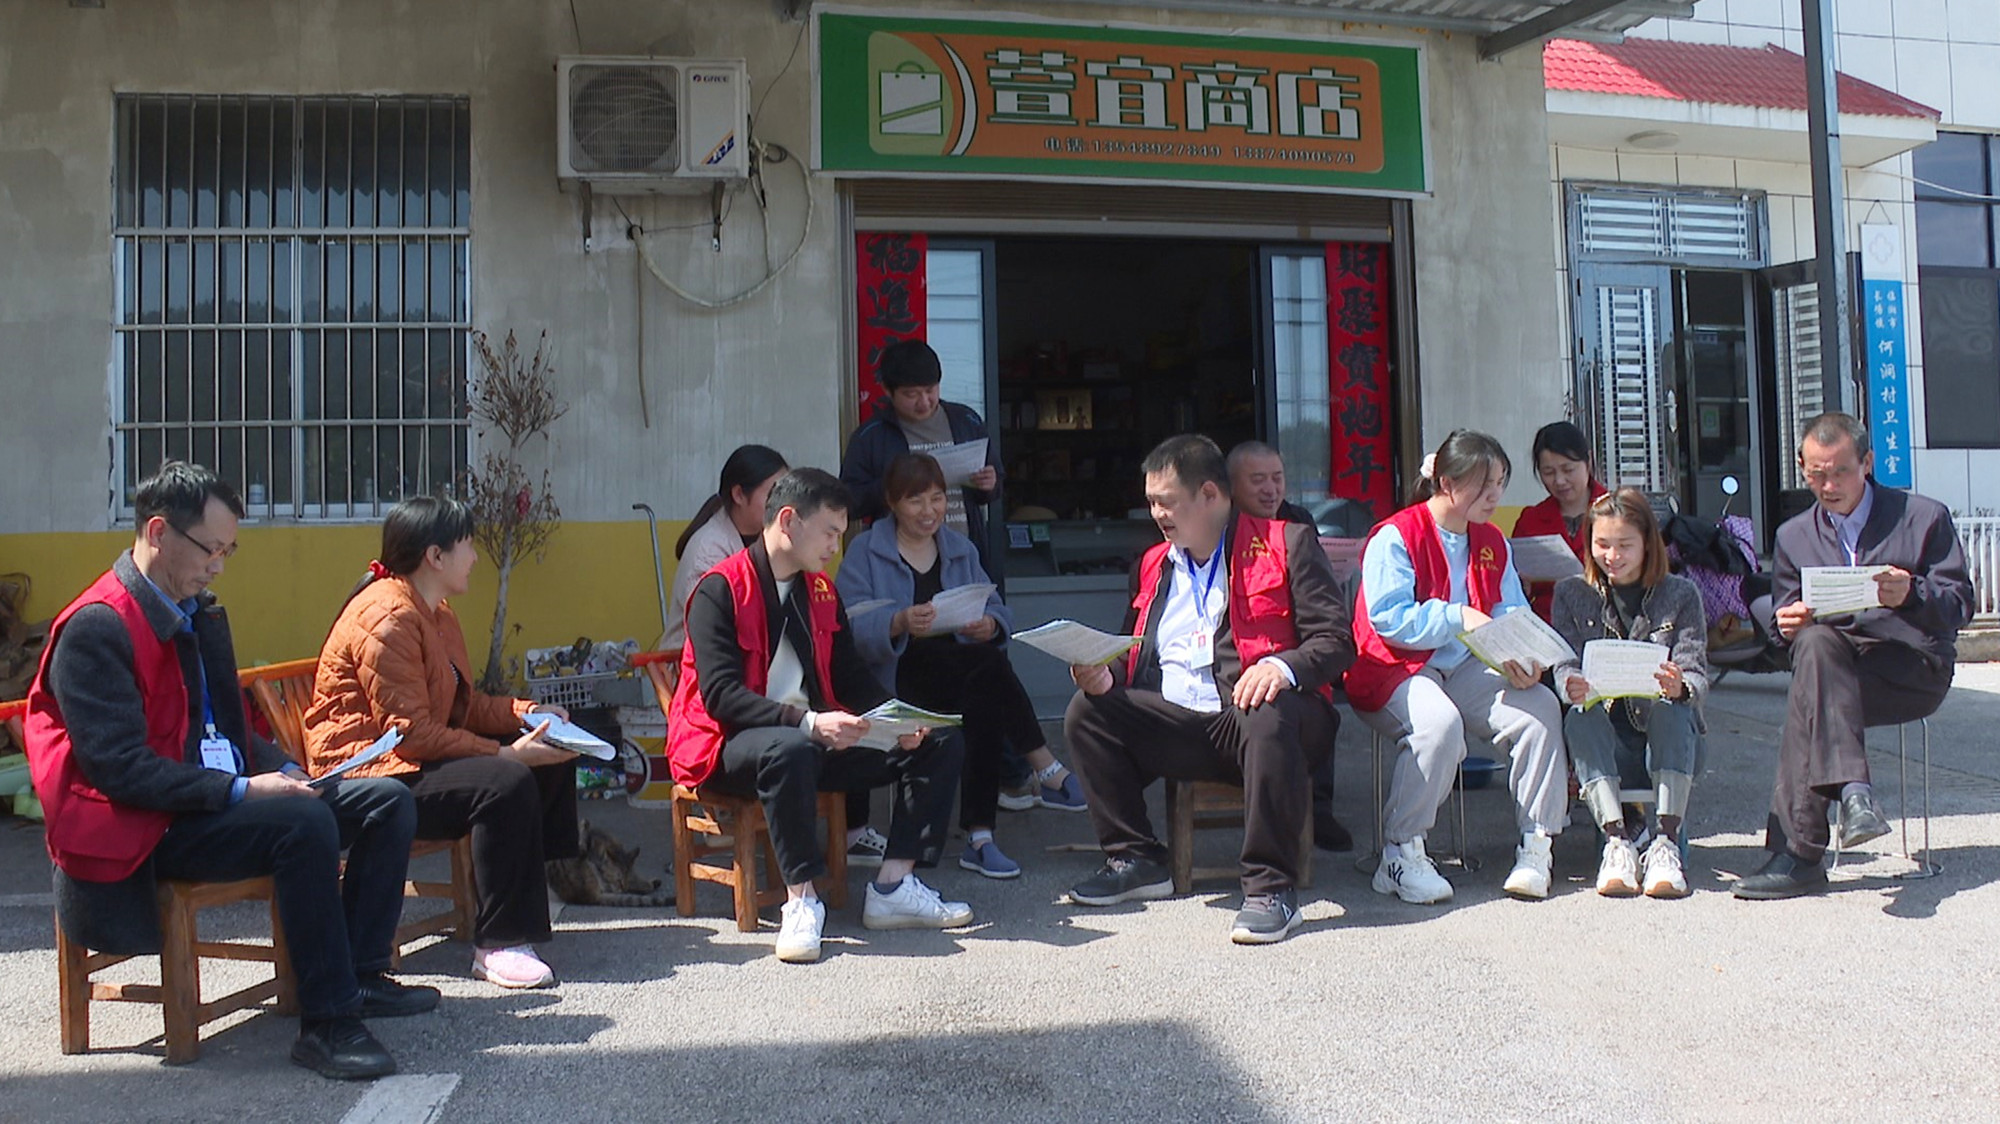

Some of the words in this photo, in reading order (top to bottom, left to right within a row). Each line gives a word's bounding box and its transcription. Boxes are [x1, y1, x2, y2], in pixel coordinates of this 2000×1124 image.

[985, 48, 1362, 140] 萱宜商店
[1337, 243, 1386, 508] 財聚寶地年
